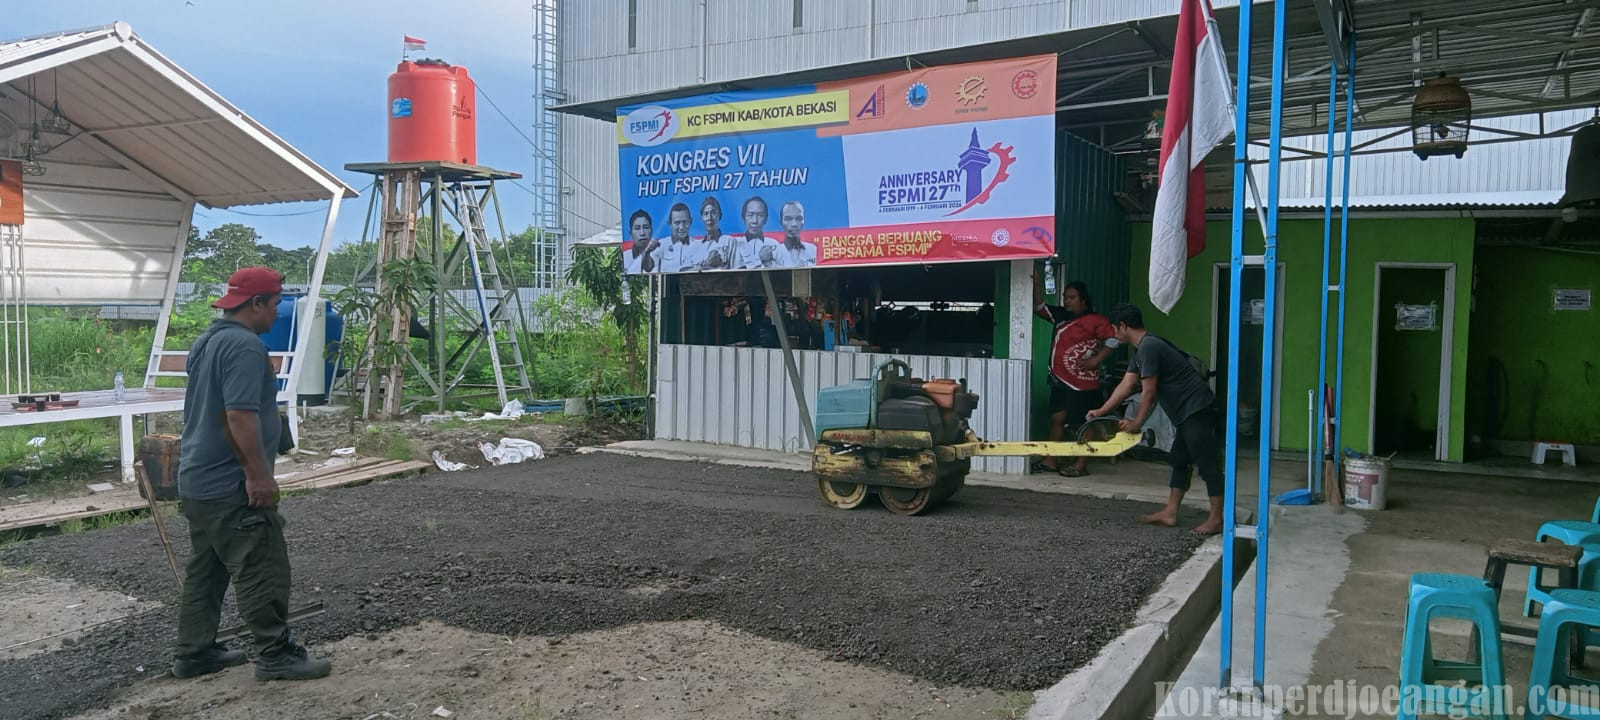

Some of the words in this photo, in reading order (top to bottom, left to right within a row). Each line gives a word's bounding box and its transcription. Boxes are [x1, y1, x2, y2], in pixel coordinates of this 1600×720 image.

[687, 116, 702, 127] KC
[703, 111, 735, 125] FSPMI
[738, 104, 794, 121] KAB/KOTA
[796, 101, 837, 116] BEKASI
[630, 119, 659, 132] FSPMI
[636, 146, 731, 177] KONGRES
[737, 143, 766, 167] VII
[638, 179, 670, 198] HUT
[674, 175, 719, 195] FSPMI
[723, 173, 743, 190] 27
[749, 167, 809, 188] TAHUN
[879, 169, 963, 189] ANNIVERSARY
[878, 187, 926, 206] FSPMI
[822, 234, 874, 248] BANGGA
[878, 230, 942, 245] BERJUANG
[823, 244, 884, 259] BERSAMA
